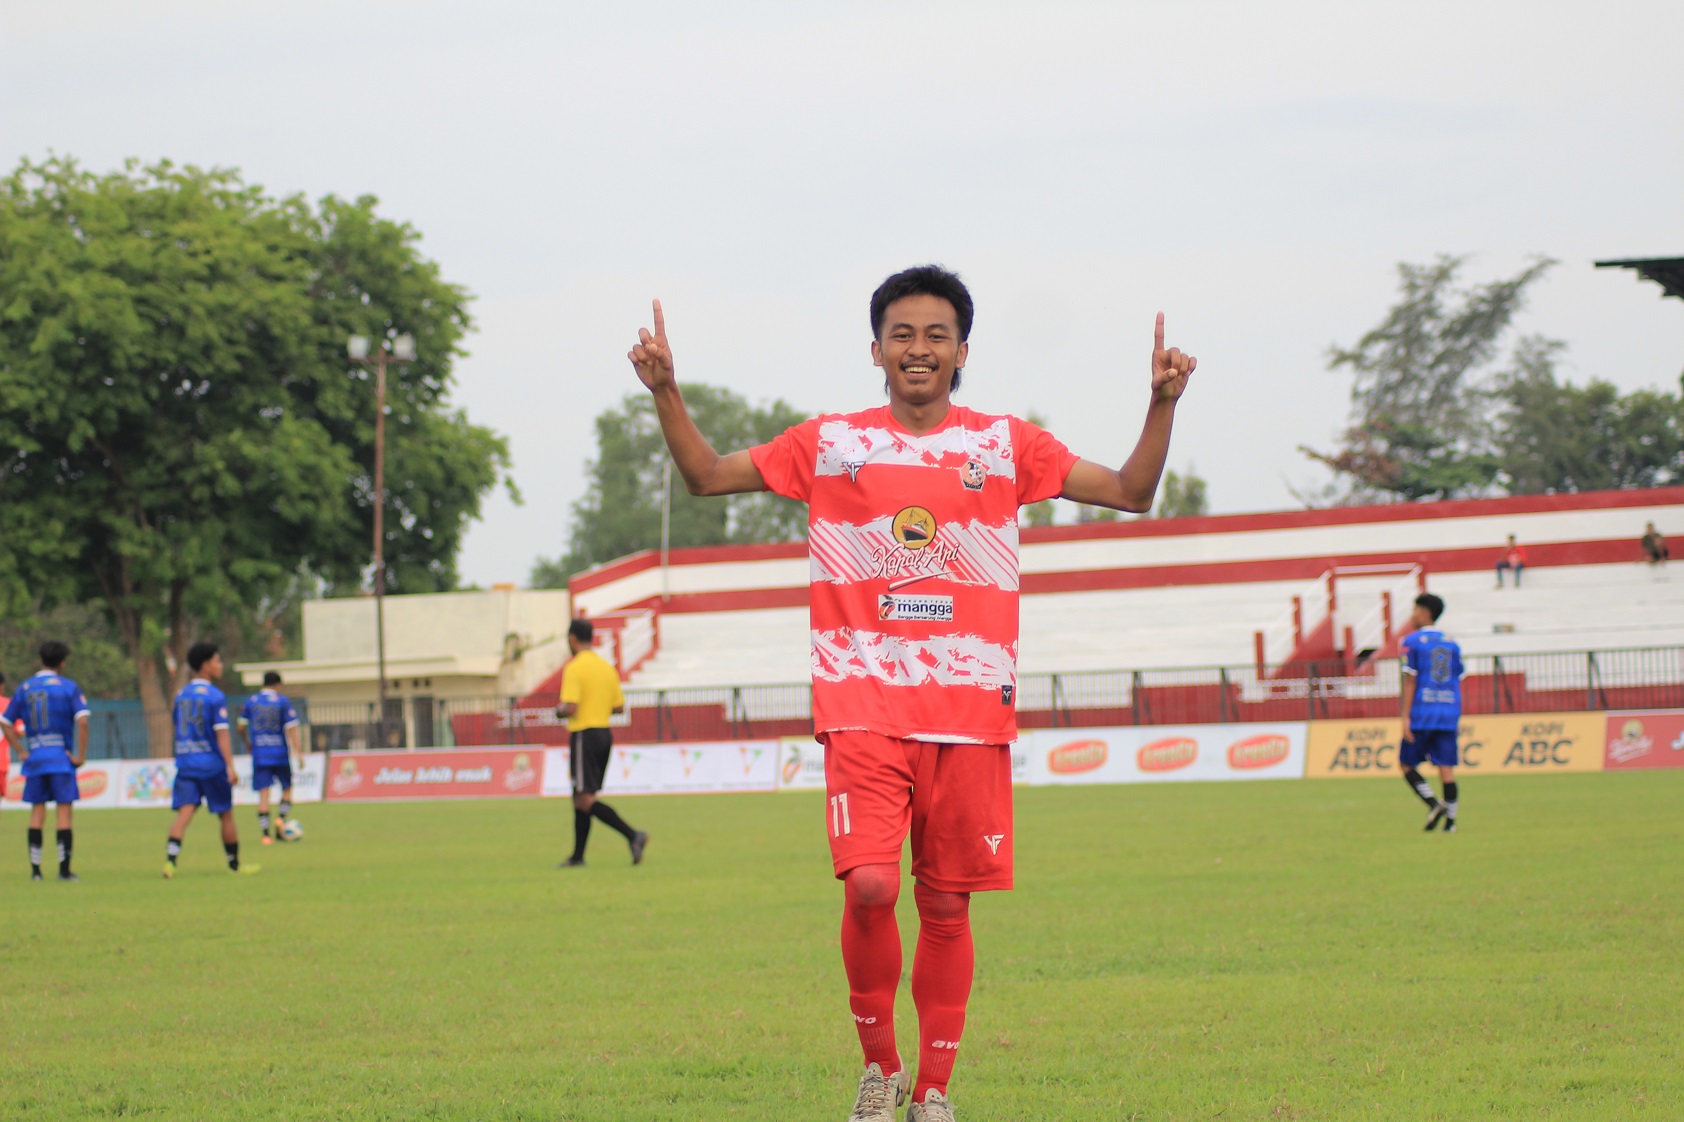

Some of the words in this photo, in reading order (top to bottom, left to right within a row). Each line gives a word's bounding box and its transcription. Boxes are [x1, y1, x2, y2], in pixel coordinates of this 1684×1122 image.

[871, 543, 925, 580] Kapal
[924, 540, 961, 569] Api
[897, 603, 953, 616] mangga
[1431, 646, 1450, 684] 8
[27, 690, 48, 730] 11
[178, 698, 204, 737] 14
[1346, 728, 1388, 741] KOPI
[1522, 722, 1565, 736] KOPI
[1330, 745, 1395, 771] ABC
[1503, 740, 1572, 767] ABC
[831, 793, 850, 838] 11
